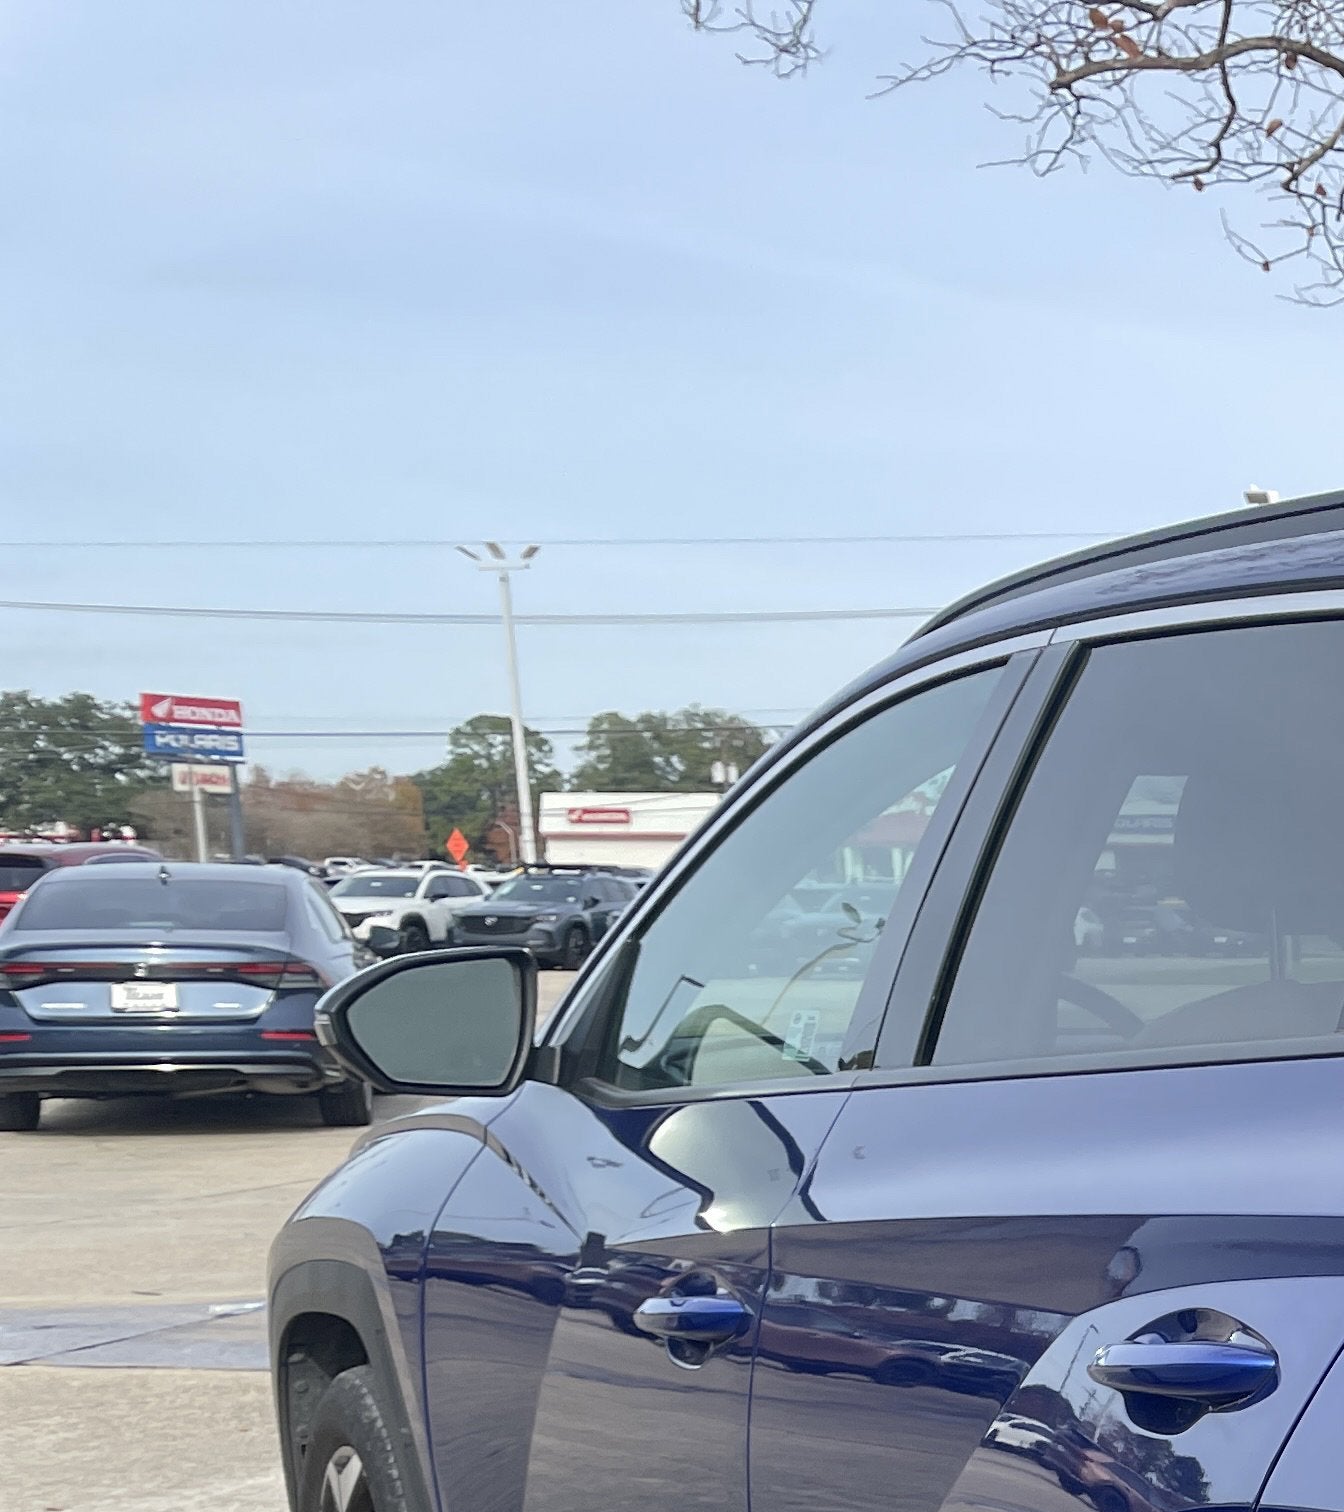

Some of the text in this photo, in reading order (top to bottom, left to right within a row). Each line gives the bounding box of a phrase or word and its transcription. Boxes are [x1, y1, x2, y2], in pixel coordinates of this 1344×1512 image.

[173, 704, 241, 722] HONDA
[154, 733, 239, 750] POLARIS
[1112, 816, 1174, 828] OLARIS
